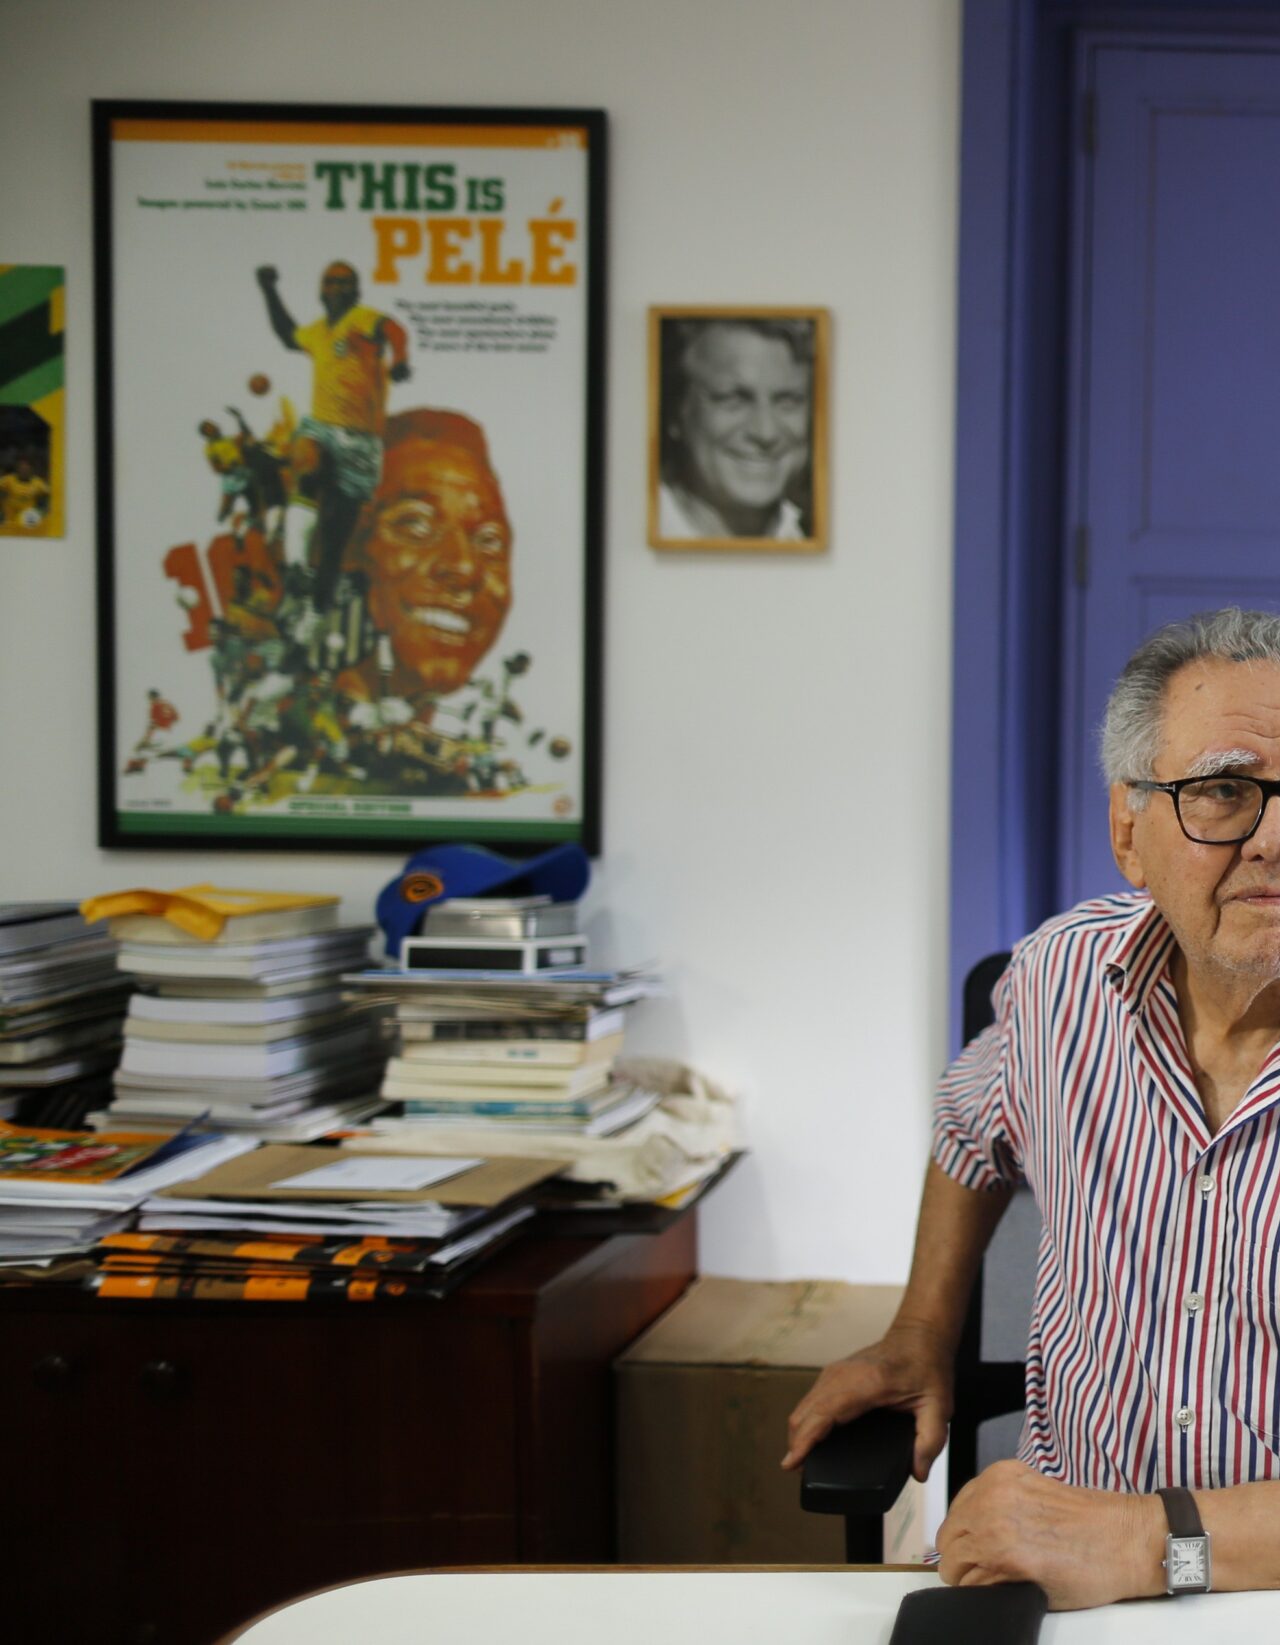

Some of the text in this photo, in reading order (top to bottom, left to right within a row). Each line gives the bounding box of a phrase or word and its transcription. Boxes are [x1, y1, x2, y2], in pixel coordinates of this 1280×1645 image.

[314, 162, 505, 213] THIS IS
[371, 196, 577, 286] PELÉ
